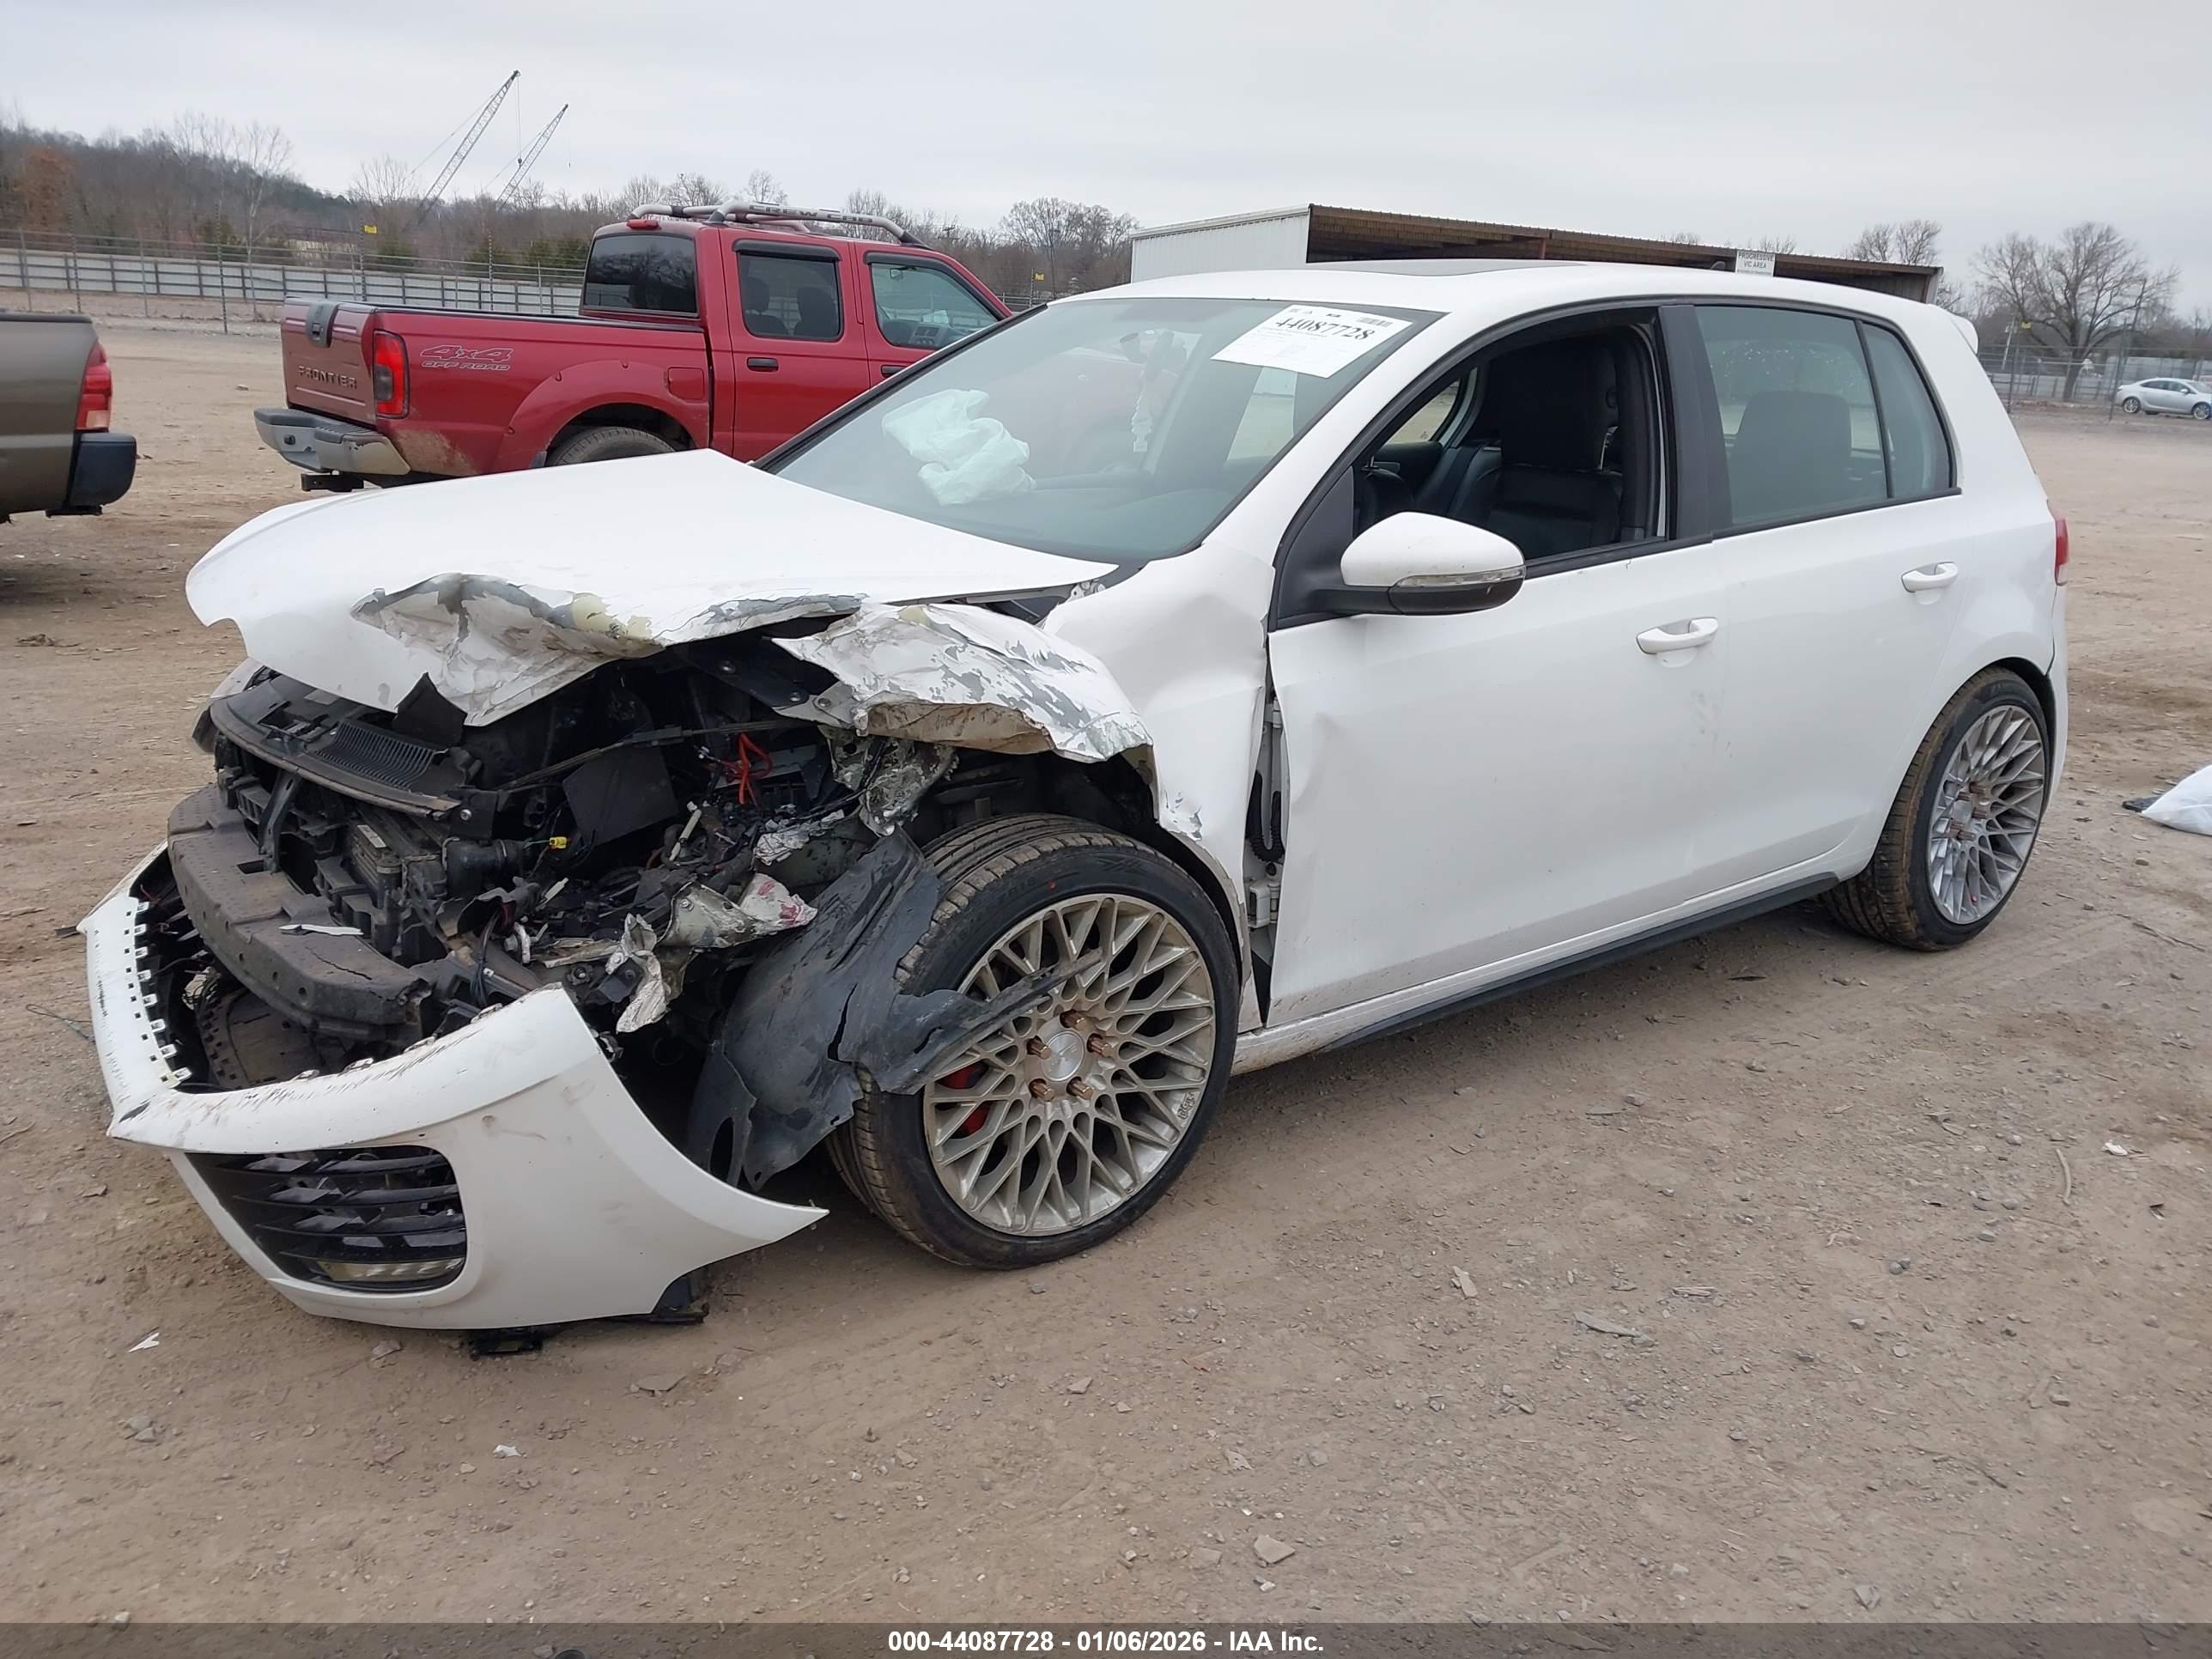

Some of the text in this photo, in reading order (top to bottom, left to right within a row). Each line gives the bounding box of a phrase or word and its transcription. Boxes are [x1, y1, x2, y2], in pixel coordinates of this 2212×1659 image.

[1753, 260, 1766, 269] AREA
[1276, 317, 1376, 340] 44087728
[421, 360, 511, 371] OFF ROAD
[298, 365, 357, 390] FRONTIER
